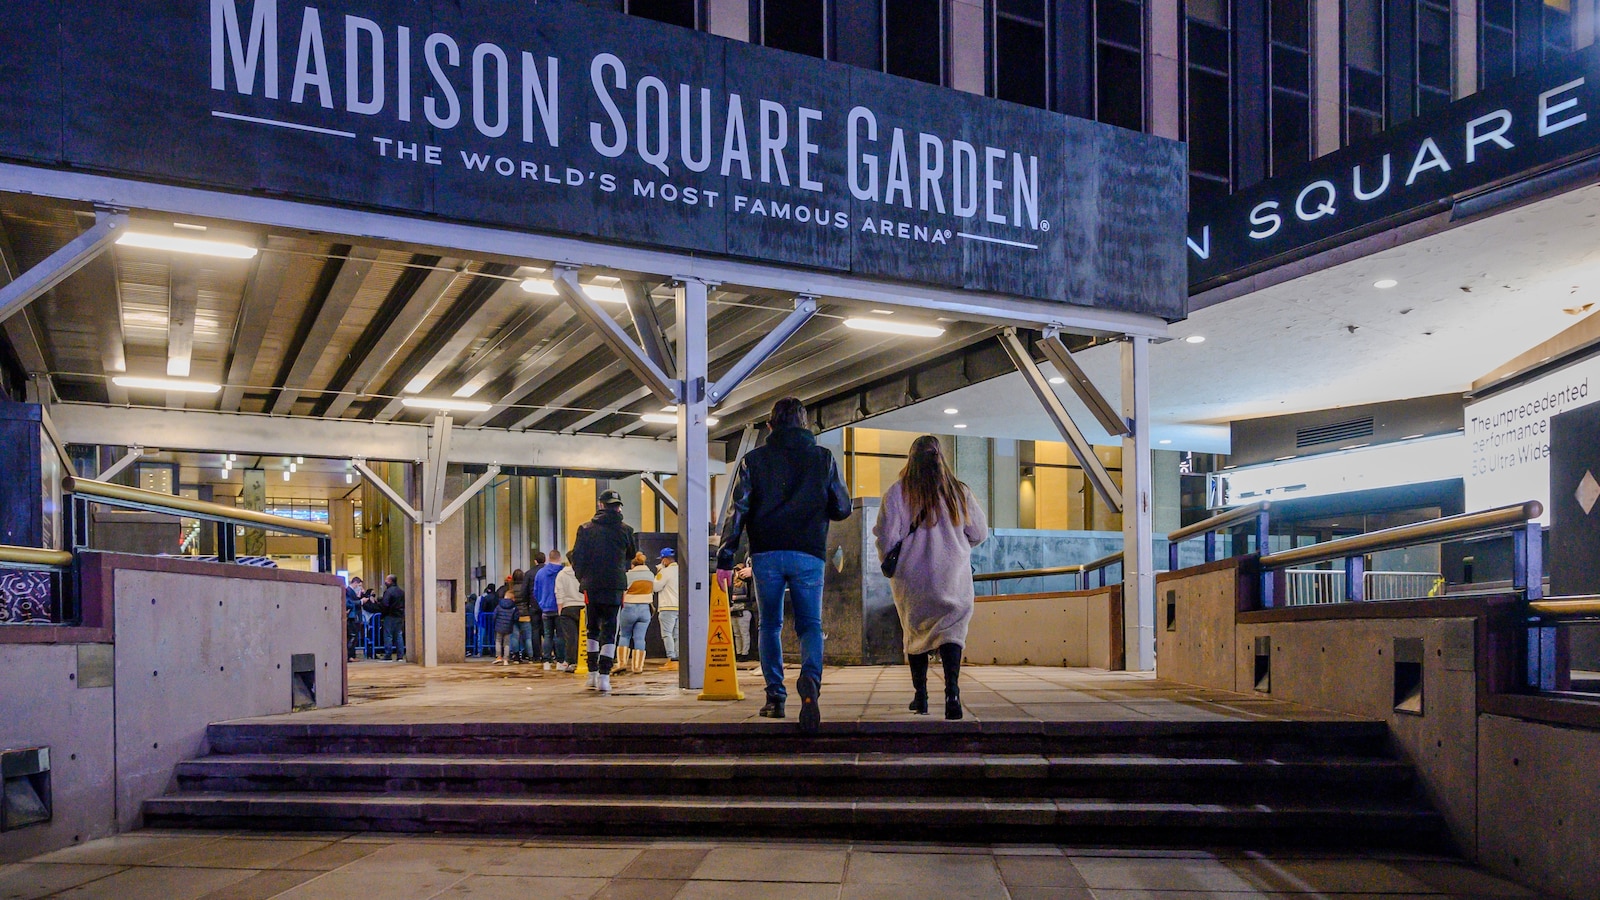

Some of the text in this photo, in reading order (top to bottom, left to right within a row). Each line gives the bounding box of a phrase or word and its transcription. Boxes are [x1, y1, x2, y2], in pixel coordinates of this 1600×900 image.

[210, 0, 559, 147] MADISON
[590, 52, 823, 192] SQUARE
[373, 137, 442, 165] THE
[460, 150, 617, 192] WORLD'S
[633, 179, 719, 208] MOST
[735, 195, 849, 229] FAMOUS
[1248, 76, 1588, 240] SQUARE
[1471, 377, 1589, 434] The unprecedented
[1472, 419, 1547, 454] performance
[1489, 451, 1516, 472] Ultra
